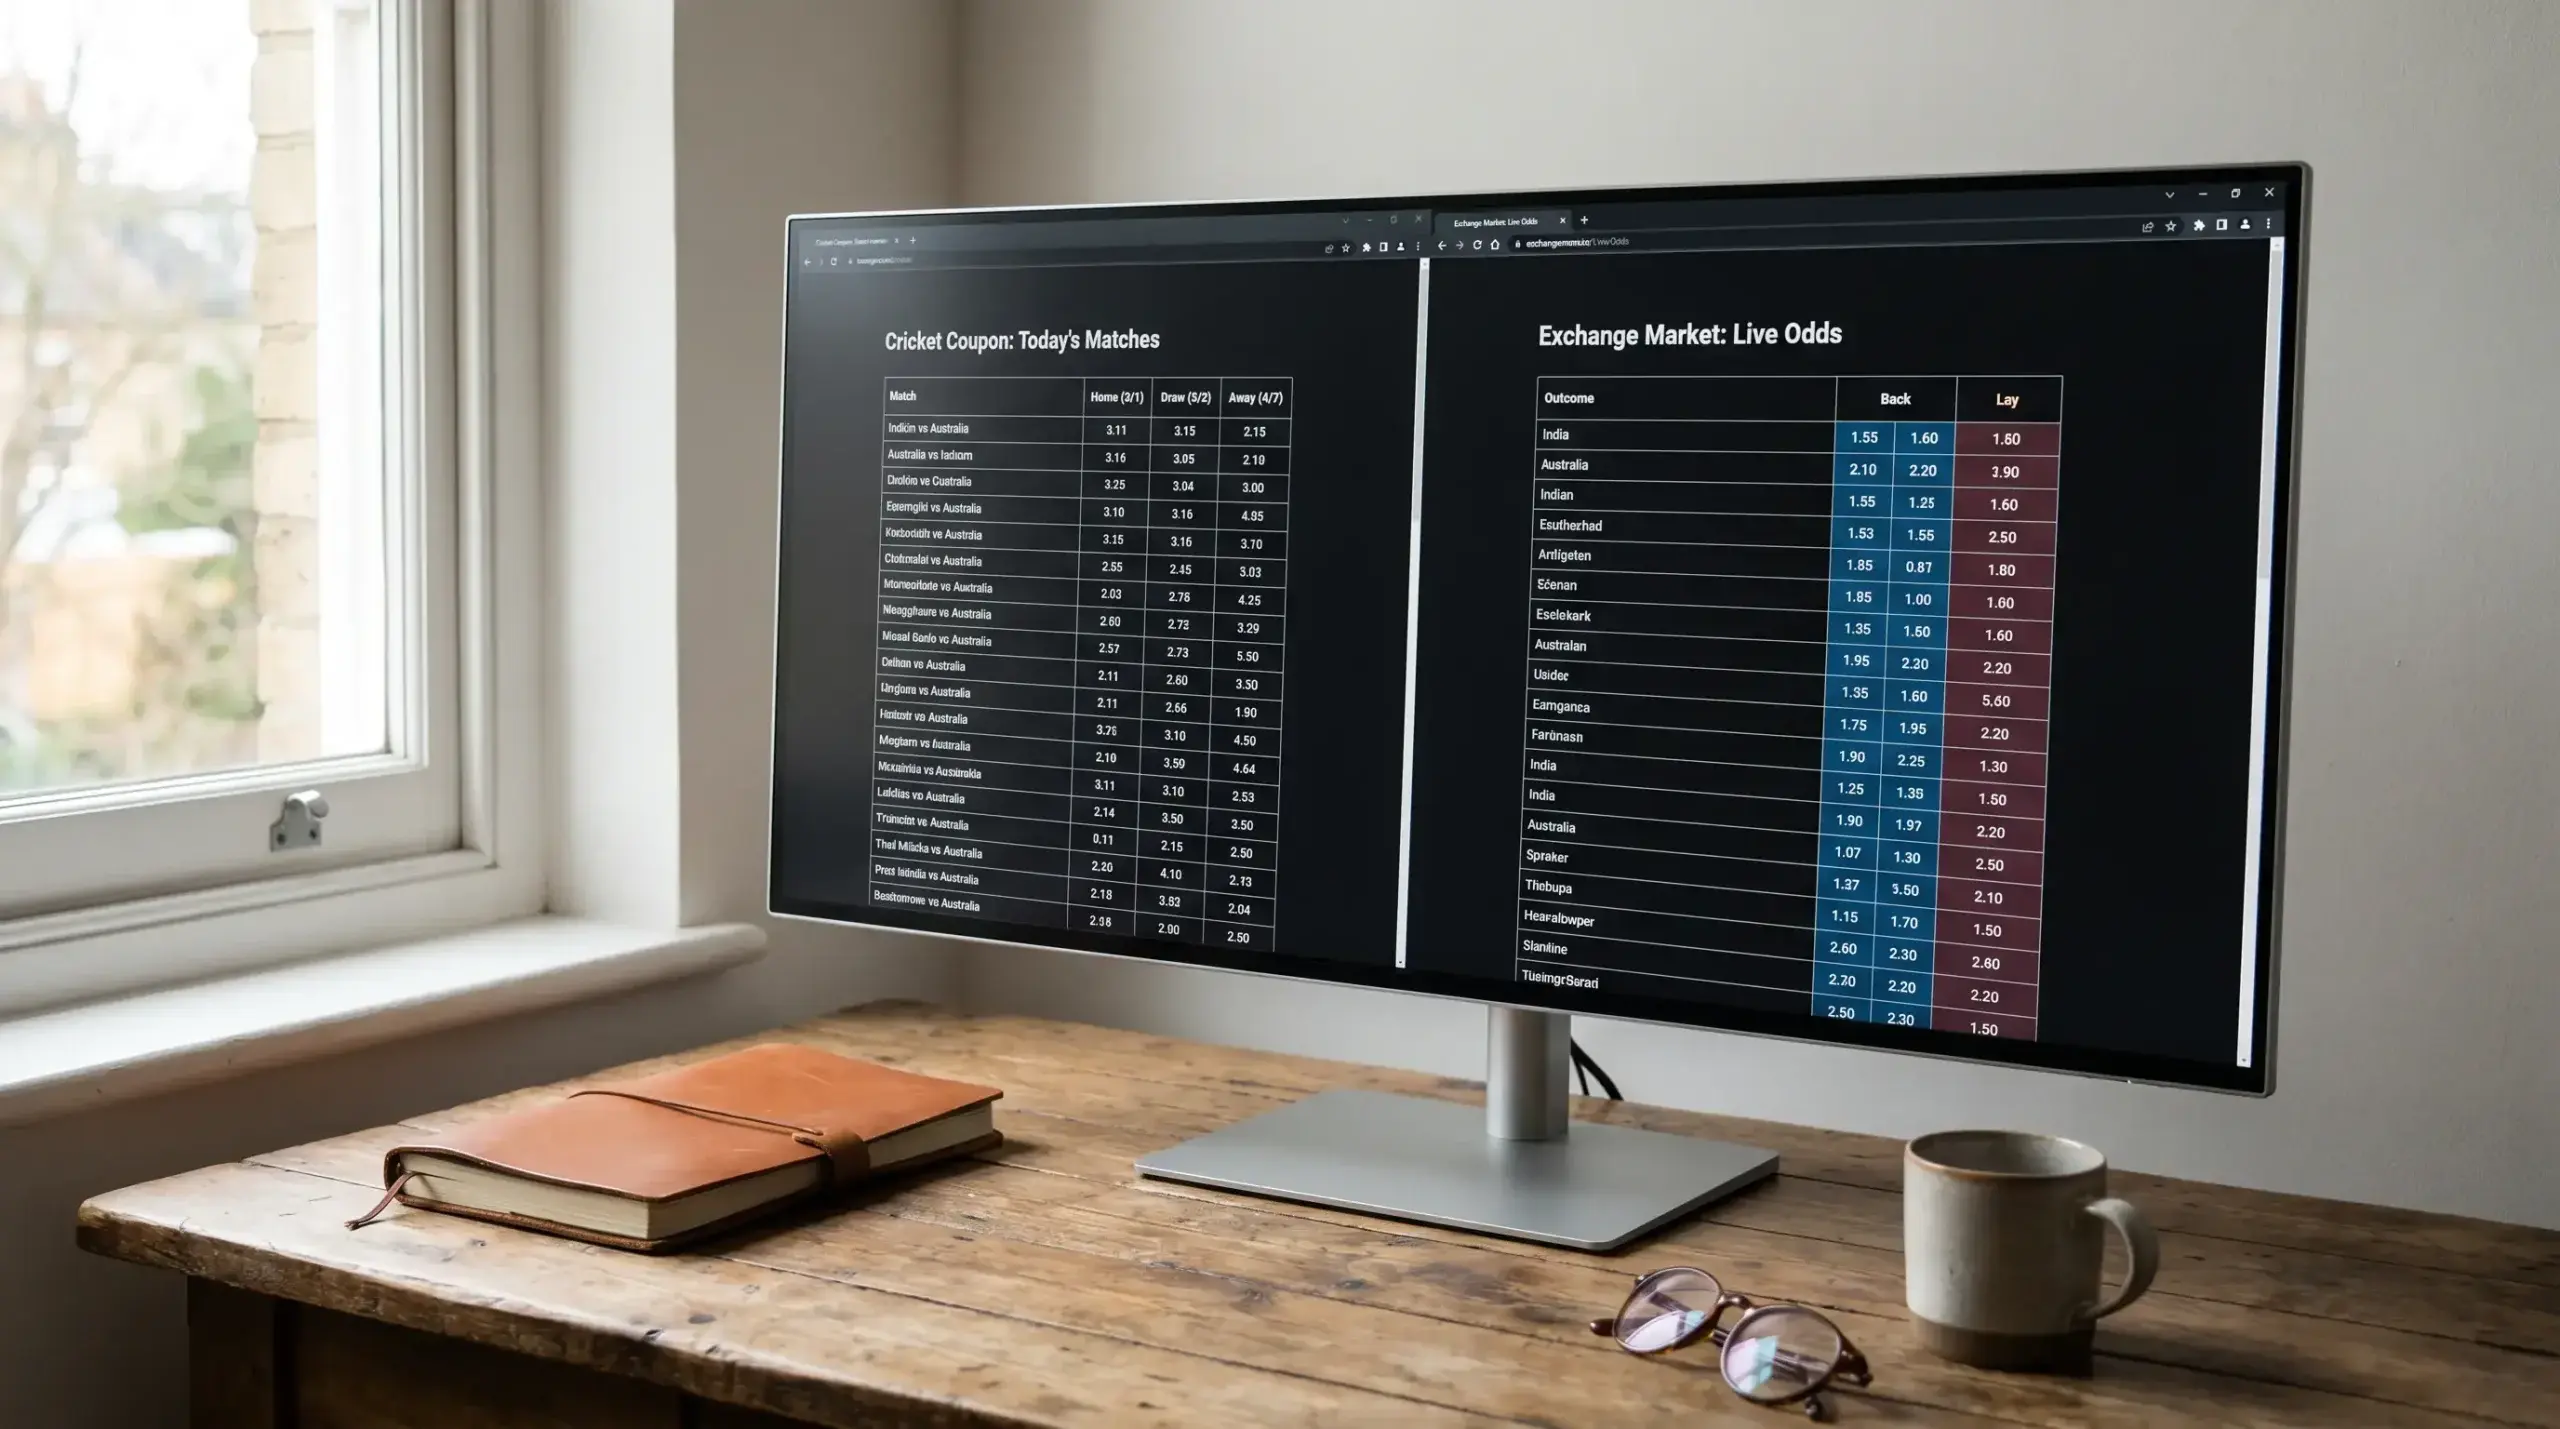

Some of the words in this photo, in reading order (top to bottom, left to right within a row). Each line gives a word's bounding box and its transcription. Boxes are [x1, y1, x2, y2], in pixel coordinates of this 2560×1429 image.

[885, 330, 943, 350] Cricket
[946, 331, 1014, 355] Coupon:
[1018, 329, 1080, 355] Today's
[1085, 328, 1160, 349] Matches
[1539, 323, 1639, 351] Exchange
[1645, 322, 1727, 345] Market:
[1733, 322, 1779, 345] Live
[1784, 320, 1843, 344] Odds
[890, 390, 917, 401] Match
[1090, 391, 1119, 402] Home
[1120, 390, 1144, 405] (3/1)
[1161, 392, 1186, 403] Draw
[1228, 392, 1256, 406] Away
[1258, 391, 1284, 406] (4/7)
[1544, 392, 1595, 404] Outcome
[1880, 392, 1912, 405] Back
[1996, 393, 2020, 409] Lay
[918, 425, 929, 433] vs
[930, 422, 969, 434] Australia
[1106, 424, 1126, 436] 3.11
[1174, 425, 1196, 437] 3.15
[1244, 426, 1266, 438] 2.15
[1543, 428, 1569, 440] India
[1851, 431, 1878, 444] 1.55
[1911, 432, 1939, 444] 1.60
[887, 449, 926, 460] Australia
[927, 451, 939, 460] vs
[1105, 452, 1126, 463] 3.16
[1173, 453, 1195, 464] 3.05
[1541, 458, 1589, 471] Australia
[1849, 463, 1877, 476] 2.10
[1909, 464, 1937, 477] 2.20
[1104, 479, 1126, 490] 3.25
[1173, 480, 1194, 492] 3.04
[1242, 482, 1265, 493] 3.00
[1540, 488, 1574, 501] Indian
[930, 504, 941, 513] vs
[942, 502, 982, 514] Australia
[1849, 495, 1876, 508] 1.55
[1909, 496, 1935, 509] 1.25
[1990, 498, 2018, 511] 1.60
[1103, 506, 1125, 518] 3.10
[1172, 508, 1193, 520] 3.16
[1103, 534, 1124, 545] 3.15
[1848, 527, 1874, 540] 1.53
[1908, 529, 1935, 542] 1.55
[1988, 530, 2017, 544] 2.50
[1171, 536, 1192, 547] 3.16
[1240, 538, 1263, 550] 3.70
[942, 555, 982, 567] Australia
[1102, 561, 1123, 572] 2.55
[1847, 559, 1873, 572] 1.85
[1906, 561, 1932, 573] 0.87
[1169, 563, 1192, 575] 2.45
[1239, 566, 1262, 578] 3.03
[1988, 564, 2016, 577] 1.80
[1101, 588, 1122, 600] 2.03
[1238, 594, 1261, 606] 4.25
[1846, 591, 1872, 603] 1.85
[1905, 593, 1932, 606] 1.00
[1987, 596, 2015, 609] 1.60
[951, 607, 992, 620] Australia
[1100, 615, 1121, 627] 2.60
[1237, 622, 1260, 634] 3.29
[1845, 622, 1871, 635] 1.35
[951, 634, 992, 647] Australia
[1985, 629, 2013, 642] 1.60
[1099, 642, 1120, 654] 2.57
[1167, 646, 1189, 658] 2.73
[1236, 650, 1259, 662] 5.50
[1843, 654, 1870, 667] 1.95
[925, 659, 966, 672] Australia
[1901, 657, 1929, 670] 2.30
[1983, 661, 2012, 675] 2.20
[1098, 669, 1118, 682] 2.11
[1235, 678, 1259, 691] 3.50
[930, 685, 971, 699] Australia
[1901, 690, 1928, 703] 1.60
[1097, 697, 1117, 709] 2.11
[1165, 701, 1187, 714] 2.66
[927, 712, 968, 725] Australia
[1235, 706, 1257, 718] 1.90
[1840, 718, 1867, 731] 1.75
[1900, 722, 1927, 735] 1.95
[1164, 729, 1186, 742] 3.10
[1981, 727, 2009, 740] 2.20
[1233, 734, 1257, 747] 4.50
[1095, 751, 1117, 763] 2.10
[1839, 750, 1866, 763] 1.90
[1897, 754, 1925, 768] 2.25
[1233, 762, 1256, 775] 4.64
[1530, 758, 1557, 771] India
[1980, 760, 2008, 773] 1.30
[1094, 779, 1115, 791] 3.11
[1162, 784, 1185, 797] 3.10
[1838, 782, 1864, 795] 1.25
[926, 790, 966, 804] Australia
[1232, 790, 1255, 803] 2.53
[1529, 788, 1556, 801] India
[1979, 793, 2007, 806] 1.50
[1094, 806, 1115, 818] 2.14
[1161, 812, 1184, 825] 3.50
[931, 817, 970, 831] Australia
[1231, 818, 1254, 831] 3.50
[1527, 818, 1576, 834] Australia
[1837, 814, 1863, 827] 1.90
[1896, 819, 1922, 832] 1.97
[1977, 825, 2006, 839] 2.20
[1093, 833, 1113, 845] 0.11
[944, 845, 984, 859] Australia
[1161, 840, 1183, 852] 2.15
[1230, 846, 1253, 859] 2.50
[1835, 846, 1861, 859] 1.07
[1894, 851, 1921, 864] 1.30
[1091, 860, 1113, 873] 2.20
[1976, 857, 2004, 872] 2.50
[940, 871, 980, 885] Australia
[1160, 867, 1182, 880] 4.10
[1833, 878, 1860, 891] 1.37
[1090, 887, 1113, 900] 2.18
[1974, 890, 2003, 905] 2.10
[941, 898, 981, 912] Australia
[1228, 903, 1251, 916] 2.04
[1832, 909, 1859, 923] 1.15
[1891, 915, 1919, 929] 1.70
[1973, 923, 2002, 937] 1.50
[1227, 930, 1250, 944] 2.50
[1830, 941, 1857, 955] 2.60
[1889, 947, 1917, 961] 2.30
[1888, 979, 1916, 994] 2.20
[1970, 989, 1999, 1003] 2.20
[1827, 1005, 1855, 1020] 2.50
[1887, 1012, 1915, 1027] 2.30
[1970, 1022, 1998, 1036] 1.50
